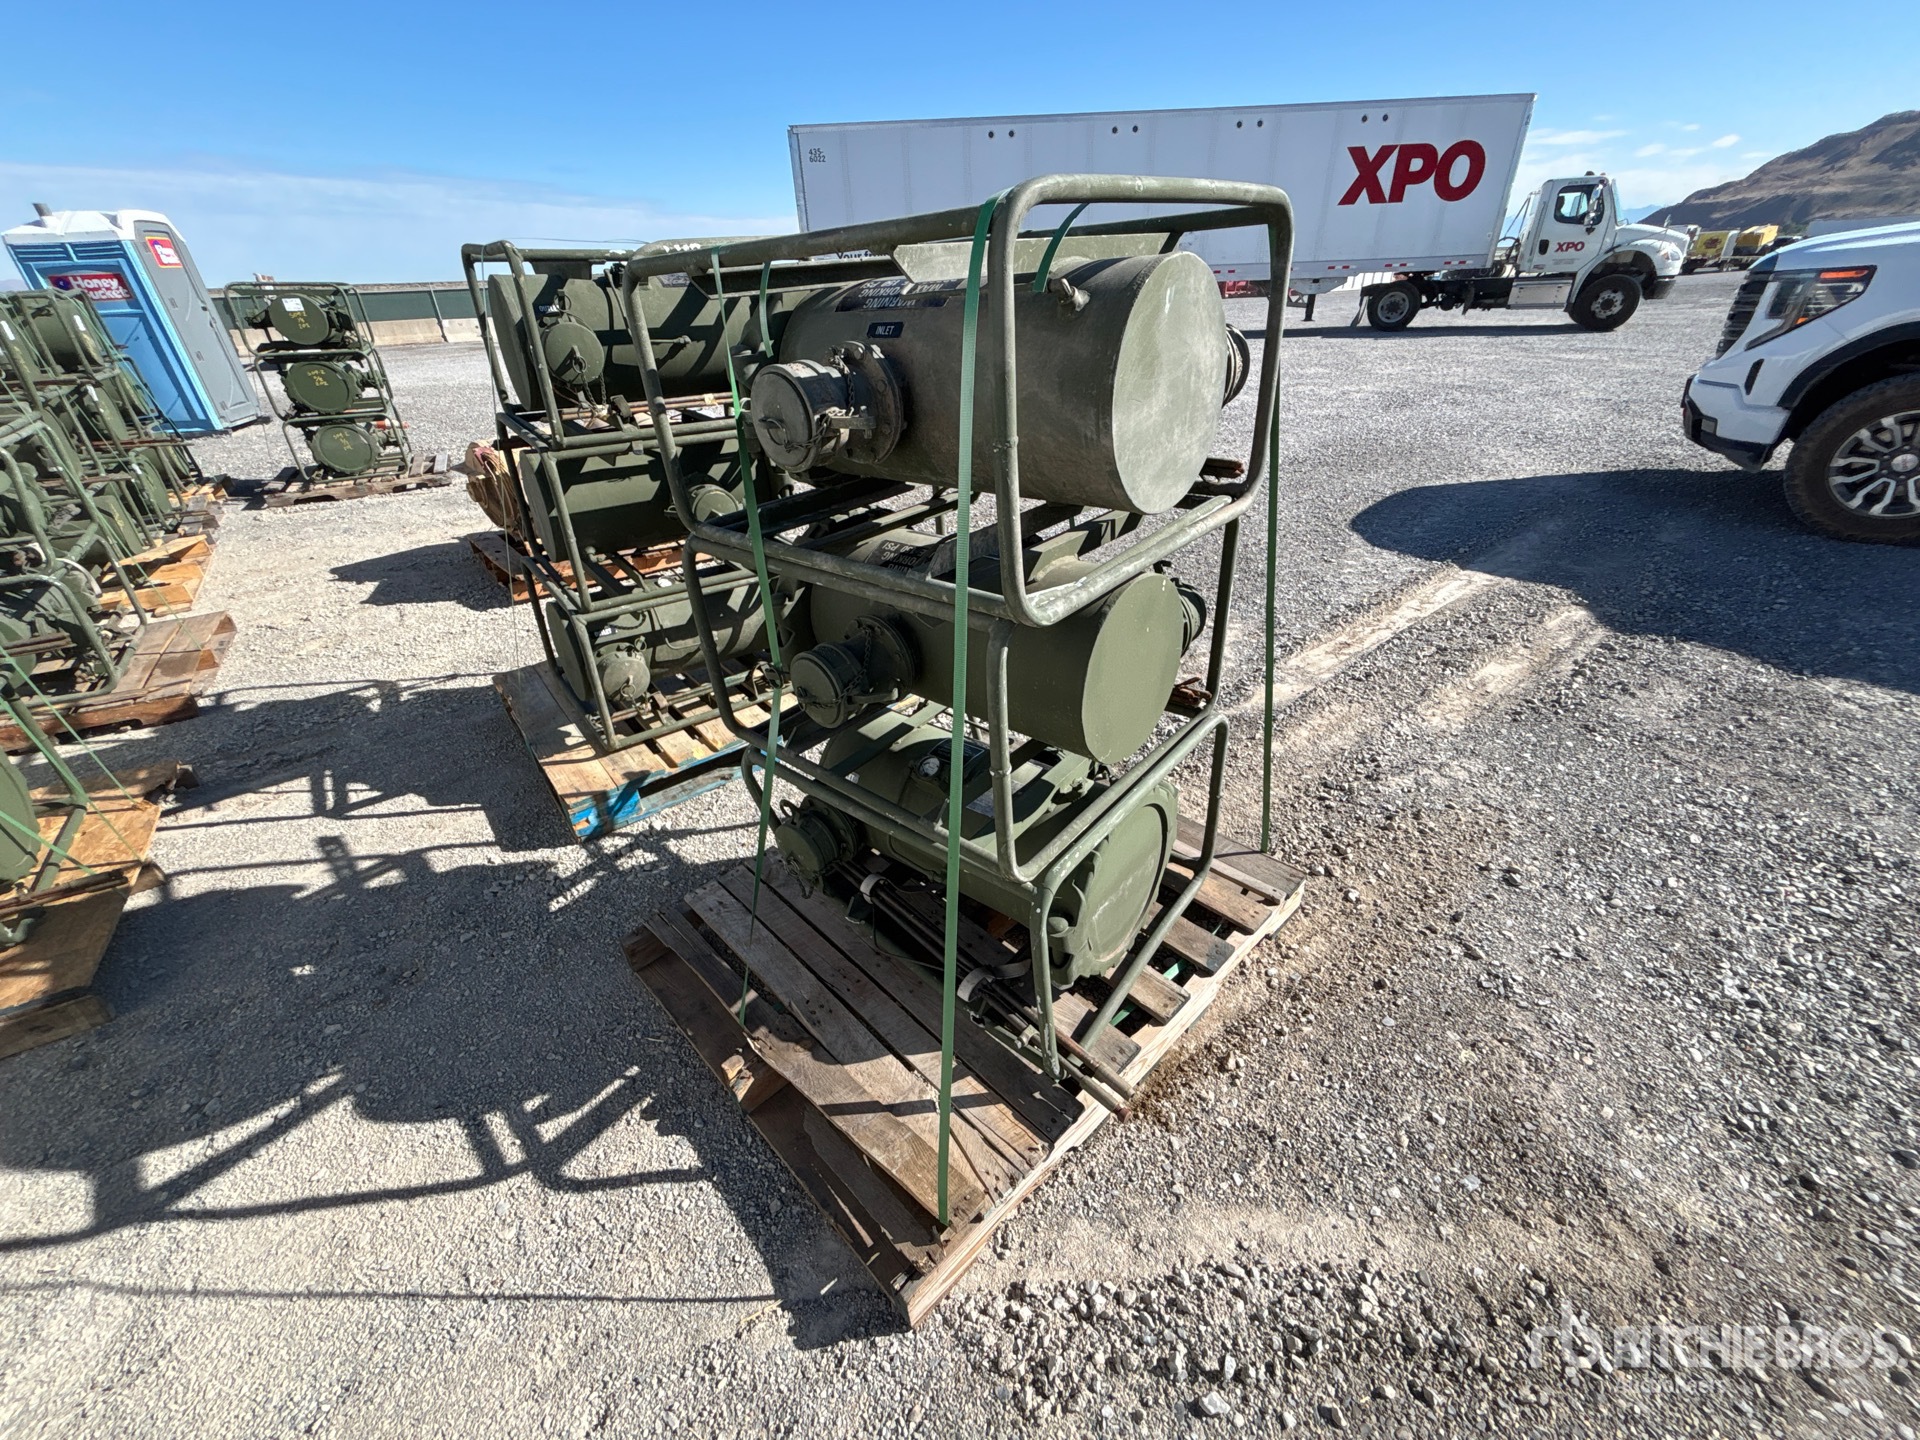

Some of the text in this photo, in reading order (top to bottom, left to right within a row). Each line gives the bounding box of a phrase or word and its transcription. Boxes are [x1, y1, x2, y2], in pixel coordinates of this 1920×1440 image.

[809, 155, 826, 163] 6022
[1337, 139, 1486, 206] XPO
[1555, 241, 1585, 253] XPO
[69, 276, 120, 290] Honey
[86, 286, 131, 299] ucket
[858, 286, 902, 298] ORKING
[875, 325, 895, 336] INLET
[881, 541, 900, 551] PSI
